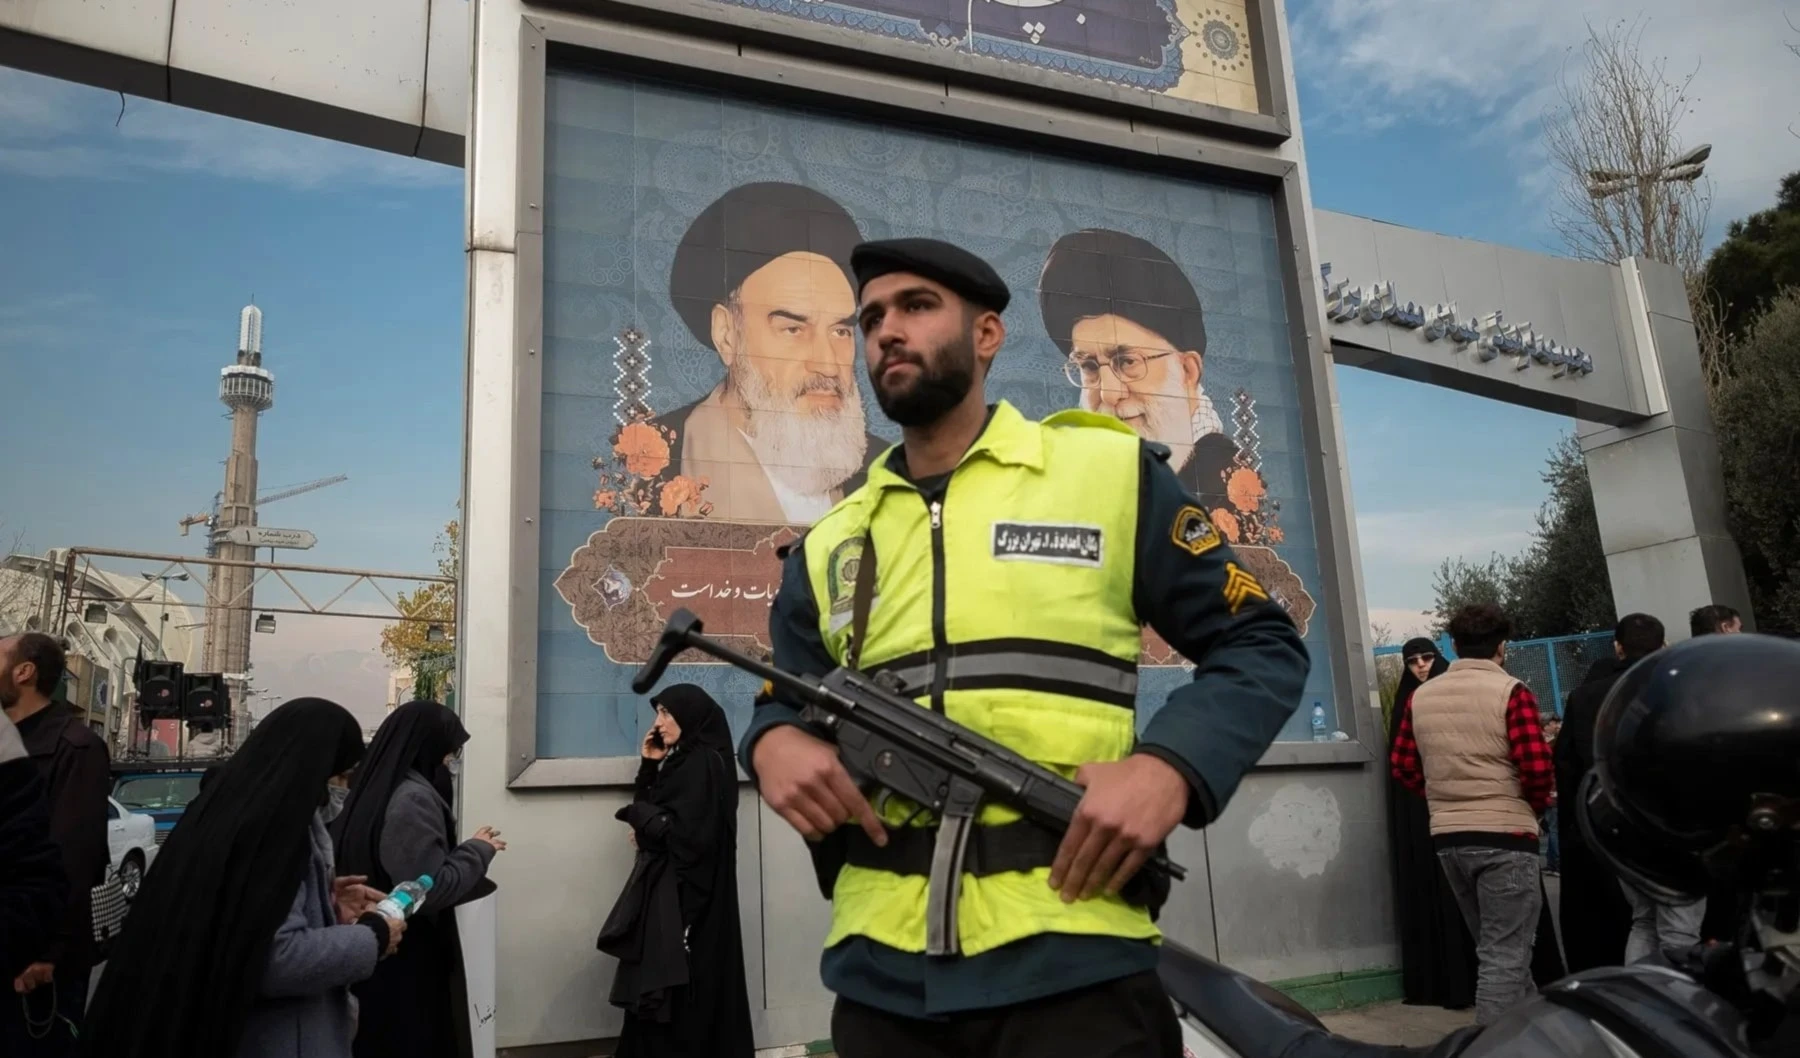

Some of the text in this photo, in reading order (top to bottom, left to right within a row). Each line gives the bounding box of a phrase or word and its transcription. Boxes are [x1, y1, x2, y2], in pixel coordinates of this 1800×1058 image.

[258, 530, 281, 538] شماره
[283, 532, 301, 540] درب
[997, 529, 1019, 552] بزرگ
[1020, 531, 1041, 553] تهران
[671, 580, 732, 598] خداست
[733, 587, 740, 598] و
